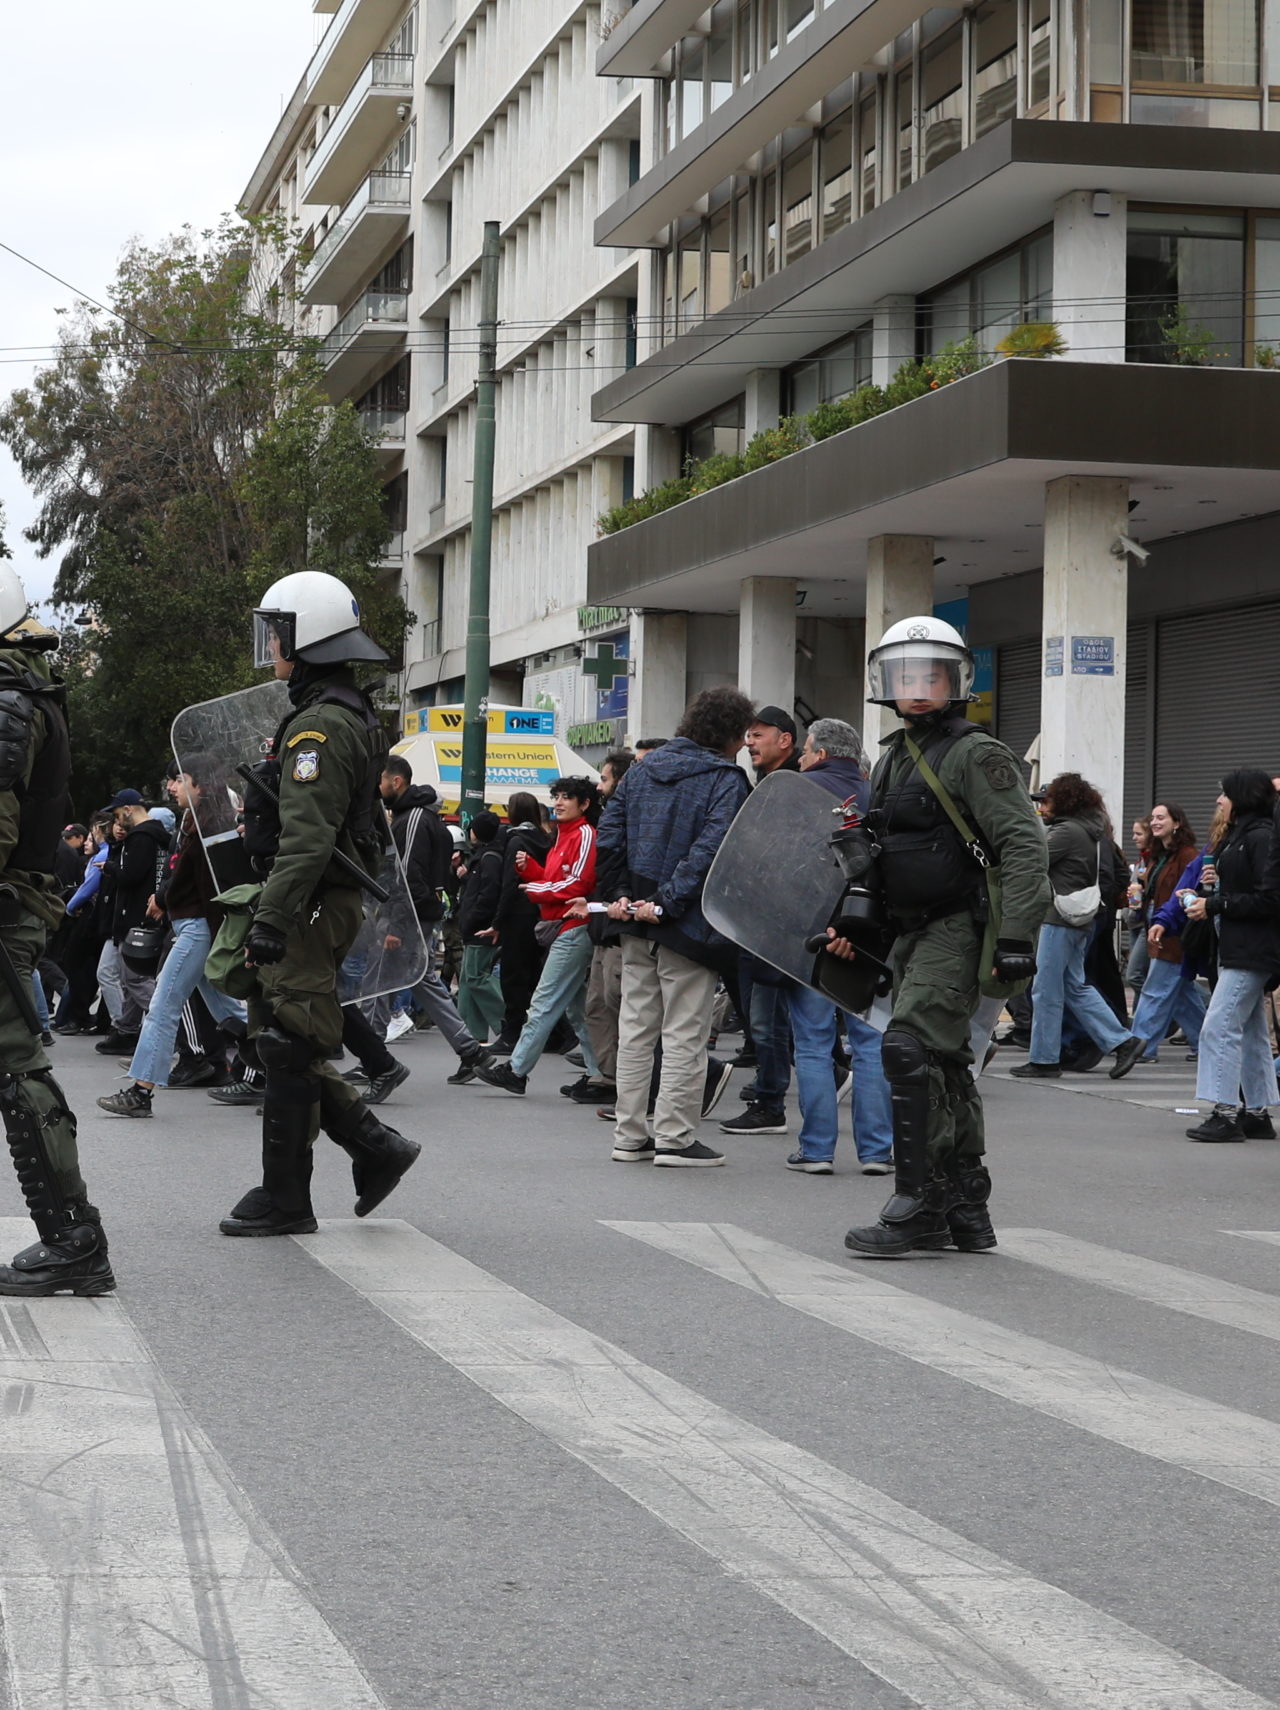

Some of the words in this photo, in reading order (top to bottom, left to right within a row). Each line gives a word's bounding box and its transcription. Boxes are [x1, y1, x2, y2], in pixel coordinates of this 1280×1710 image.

[485, 752, 516, 760] stern
[517, 752, 553, 760] Union
[485, 768, 538, 777] HANGE
[485, 776, 540, 784] ΑΛΛΑΓΜΑ
